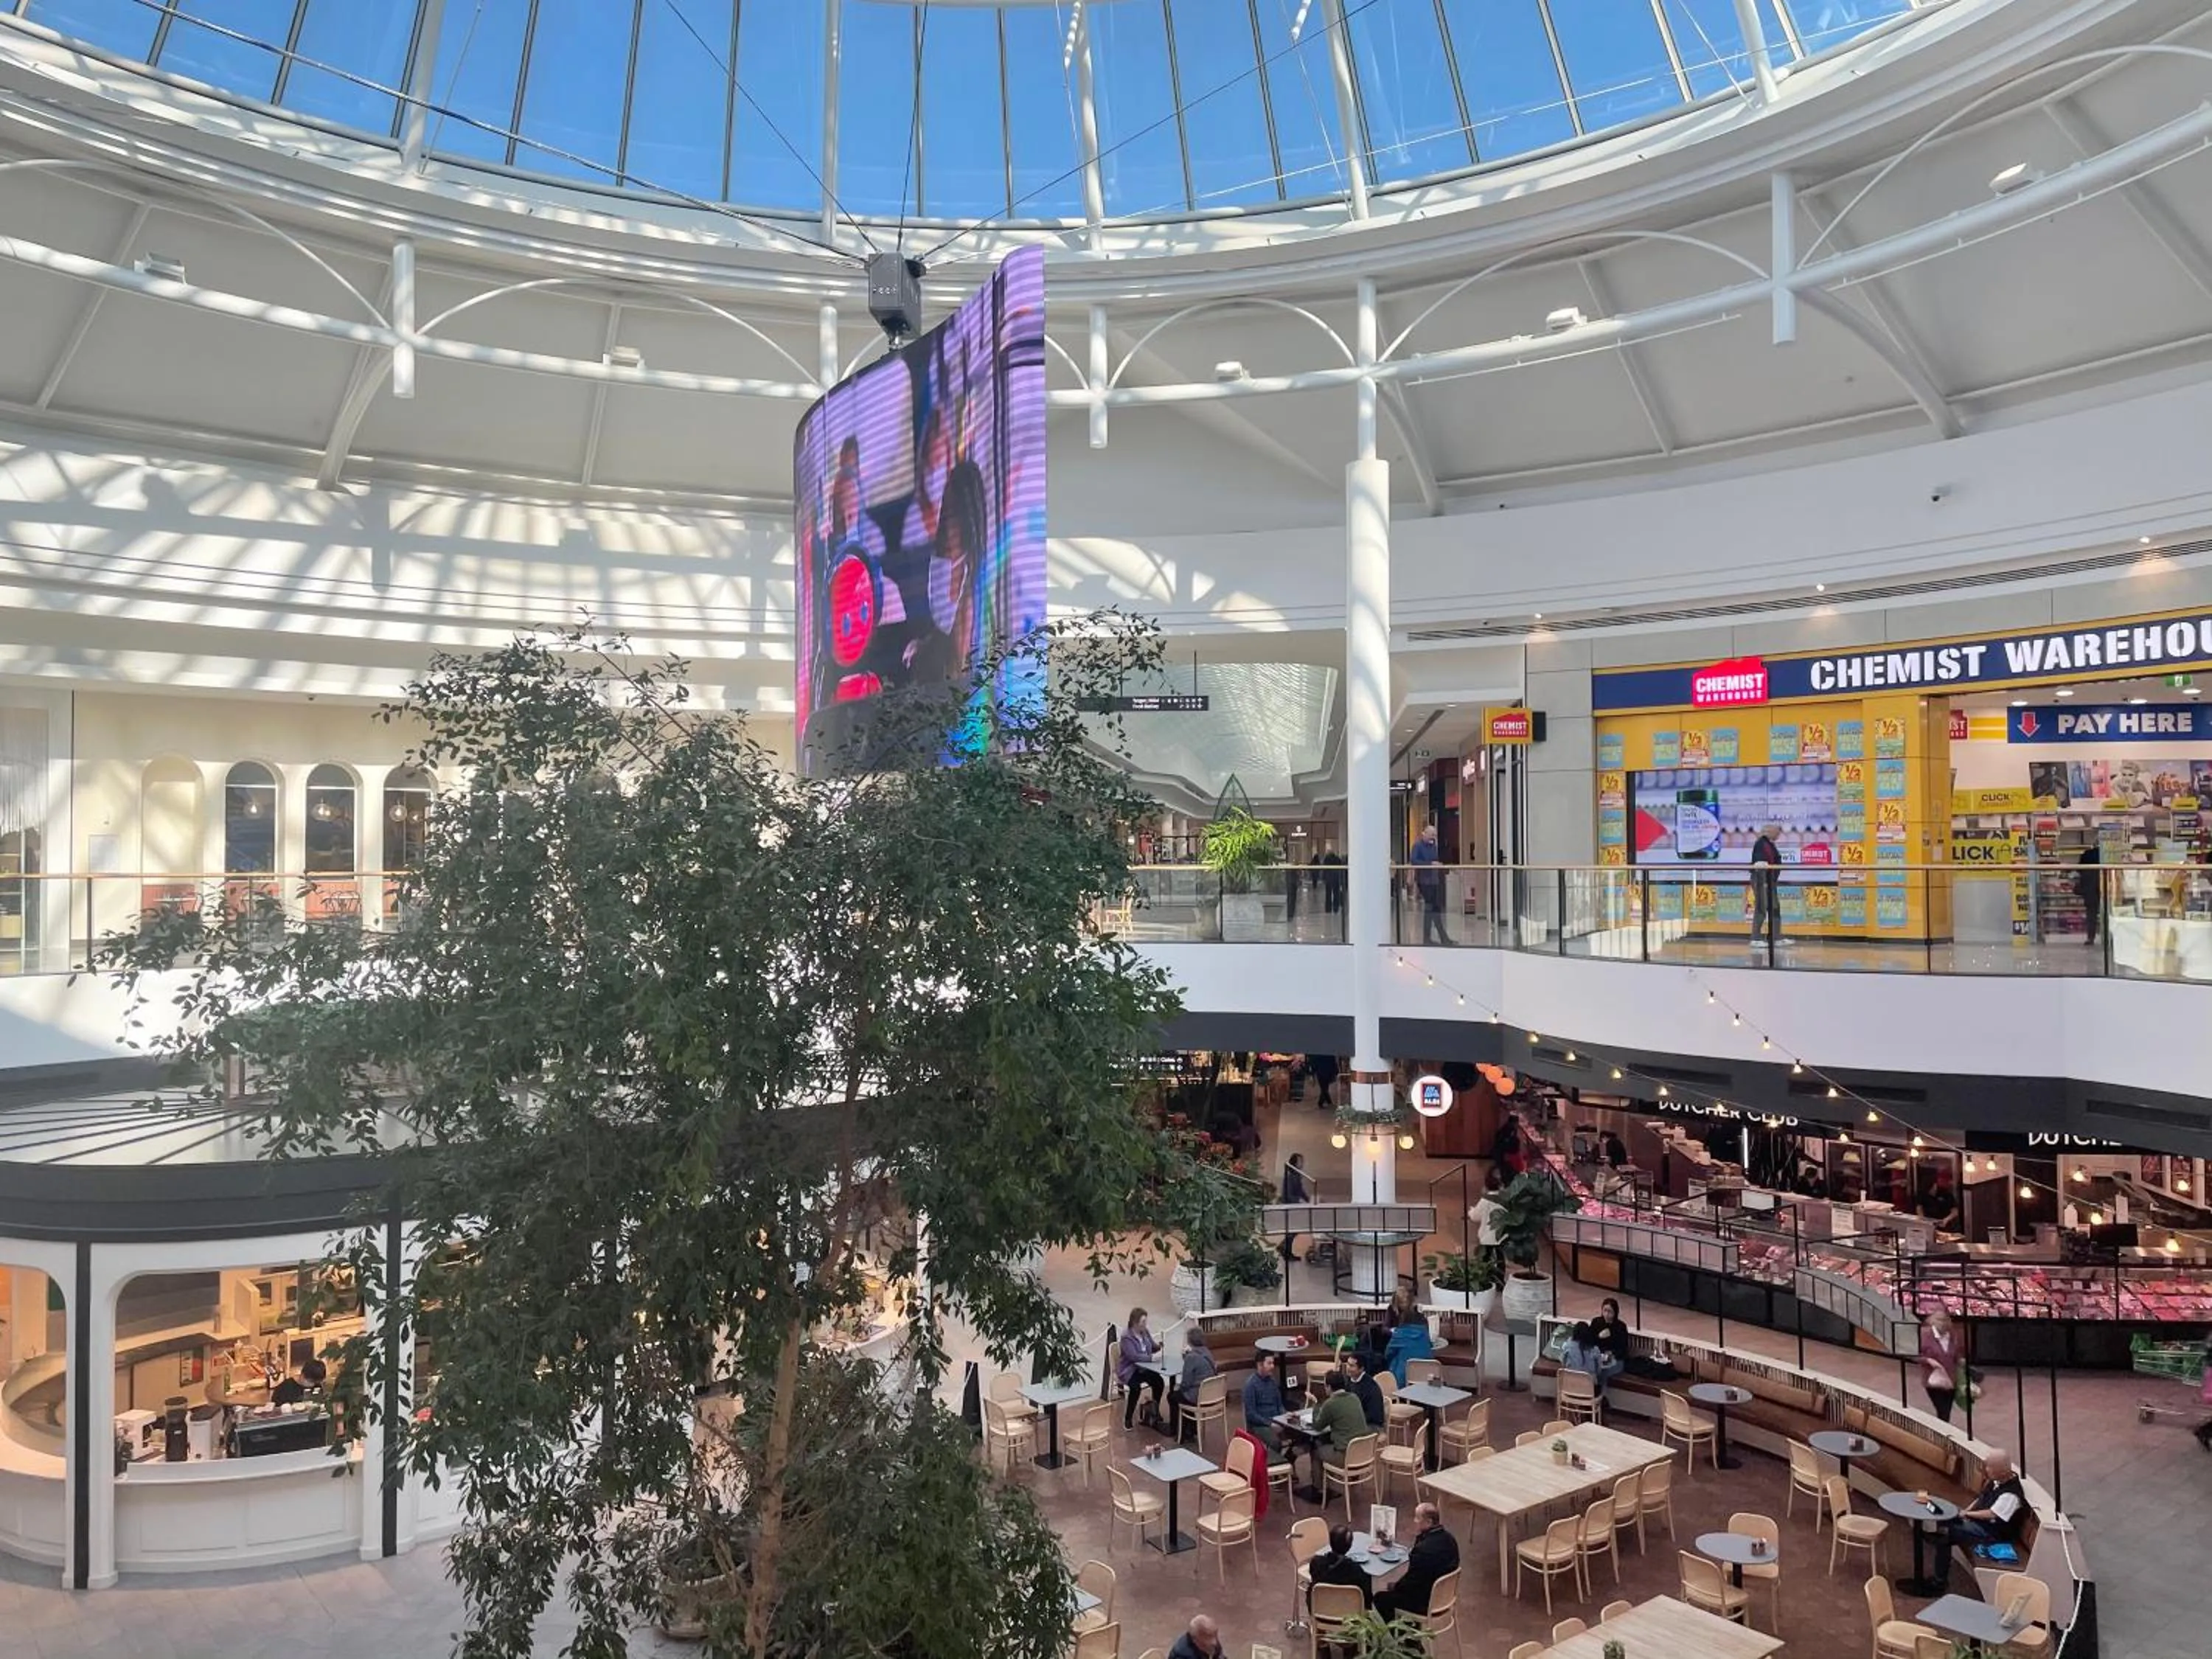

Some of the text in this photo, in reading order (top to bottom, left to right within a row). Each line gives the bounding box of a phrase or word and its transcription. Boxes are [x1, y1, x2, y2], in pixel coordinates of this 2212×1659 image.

[1811, 646, 1987, 690] CHEMIST
[1696, 673, 1764, 692] CHEMIST
[1697, 691, 1762, 703] WAREHOUSE
[1493, 721, 1526, 730] CHEMIST
[2058, 712, 2193, 734] PAY HERE
[1981, 793, 2009, 801] CLICK
[1424, 1098, 1440, 1106] ALDI
